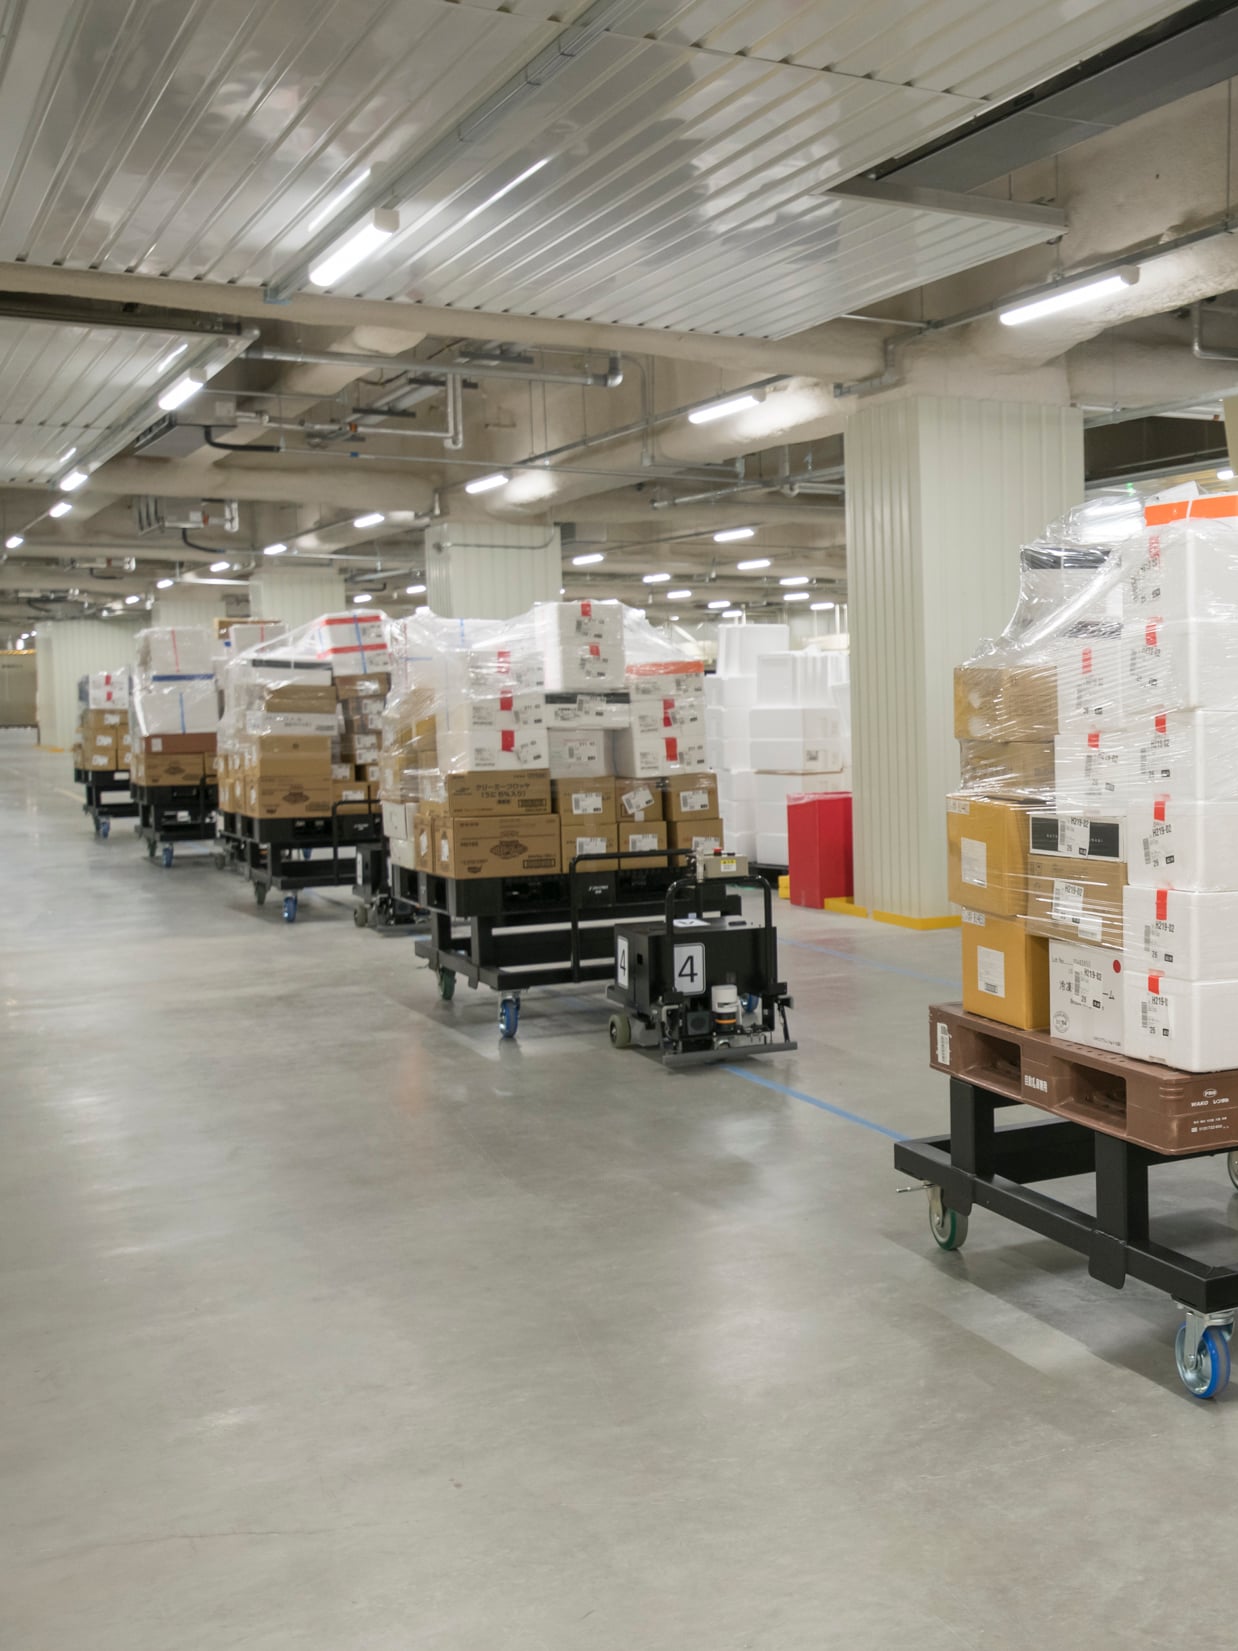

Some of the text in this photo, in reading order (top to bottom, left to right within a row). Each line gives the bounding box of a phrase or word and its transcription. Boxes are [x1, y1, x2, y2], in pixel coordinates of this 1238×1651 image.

[1152, 824, 1172, 837] H219-02
[1155, 921, 1174, 933] H219-02
[619, 948, 627, 977] 4
[677, 954, 698, 983] 4
[1084, 968, 1102, 981] H219-02
